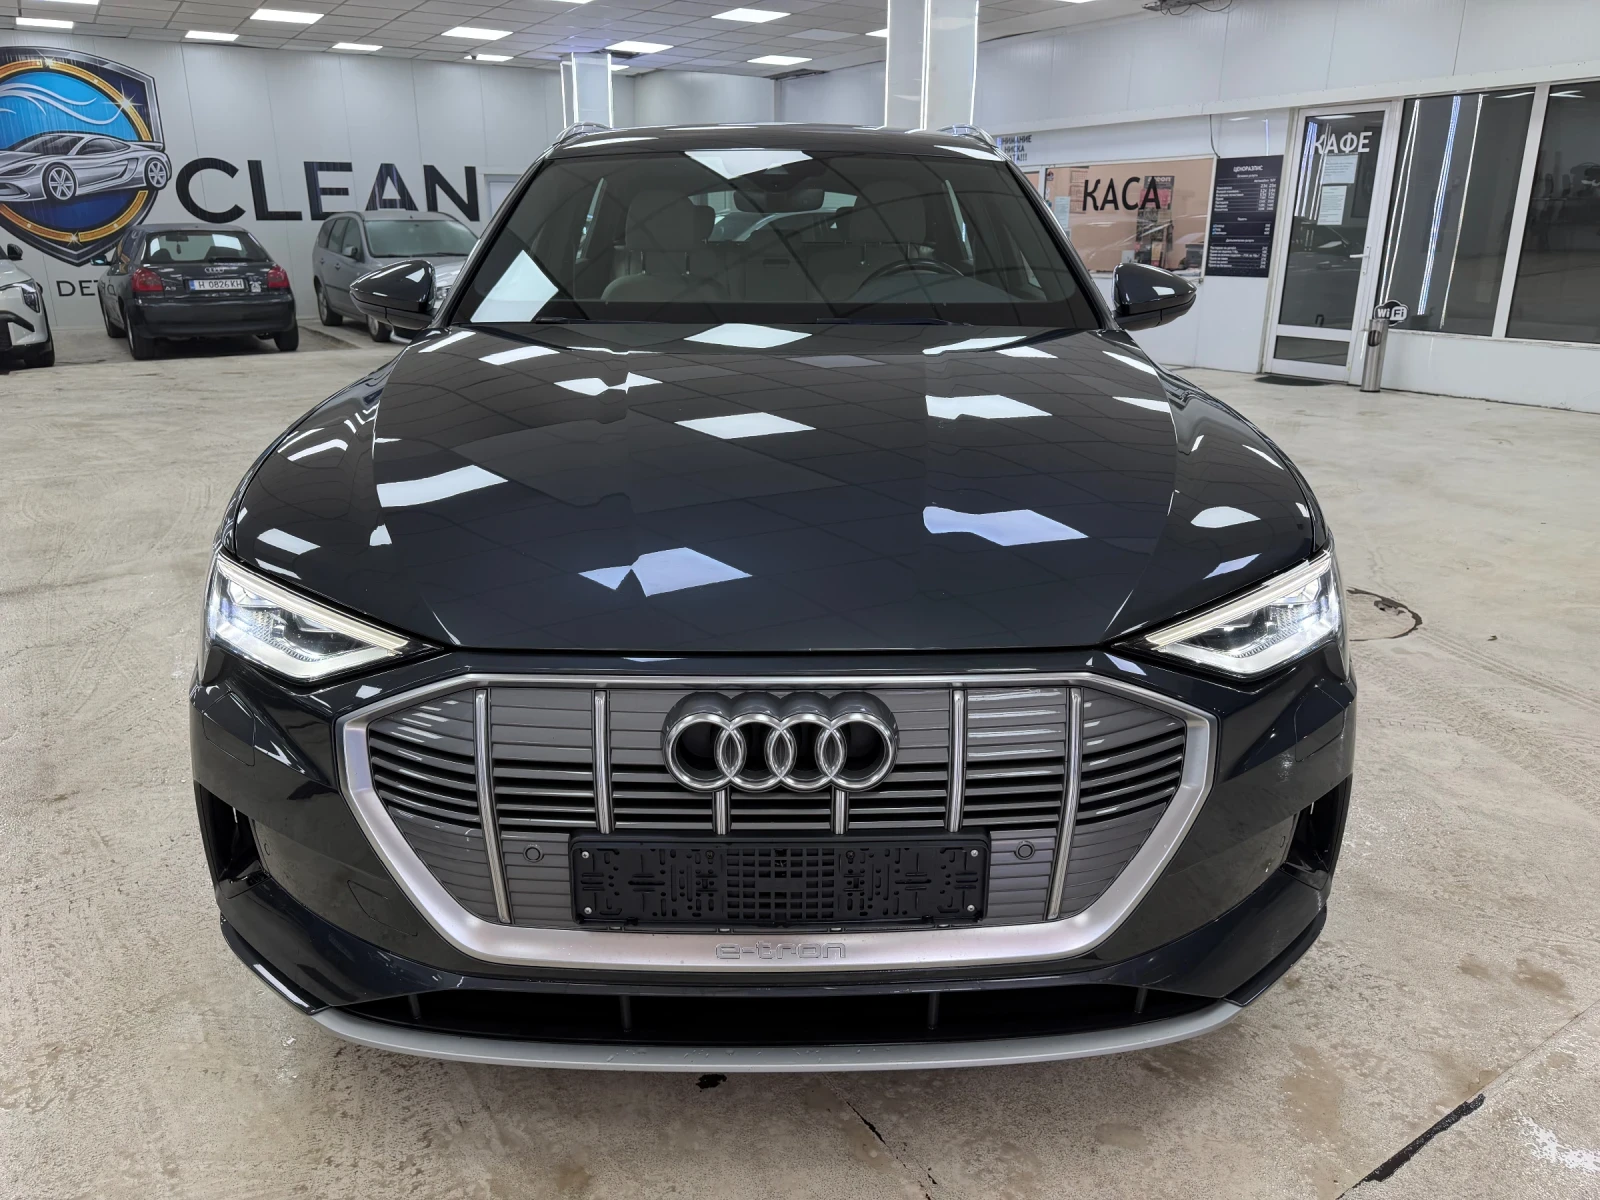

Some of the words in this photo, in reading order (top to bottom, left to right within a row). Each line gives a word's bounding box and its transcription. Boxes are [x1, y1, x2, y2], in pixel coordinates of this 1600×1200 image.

[1313, 131, 1373, 154] КАФЕ
[176, 157, 480, 223] CLEAN
[1082, 176, 1161, 211] КАСА
[56, 280, 99, 297] DE
[715, 940, 847, 959] e-tron
